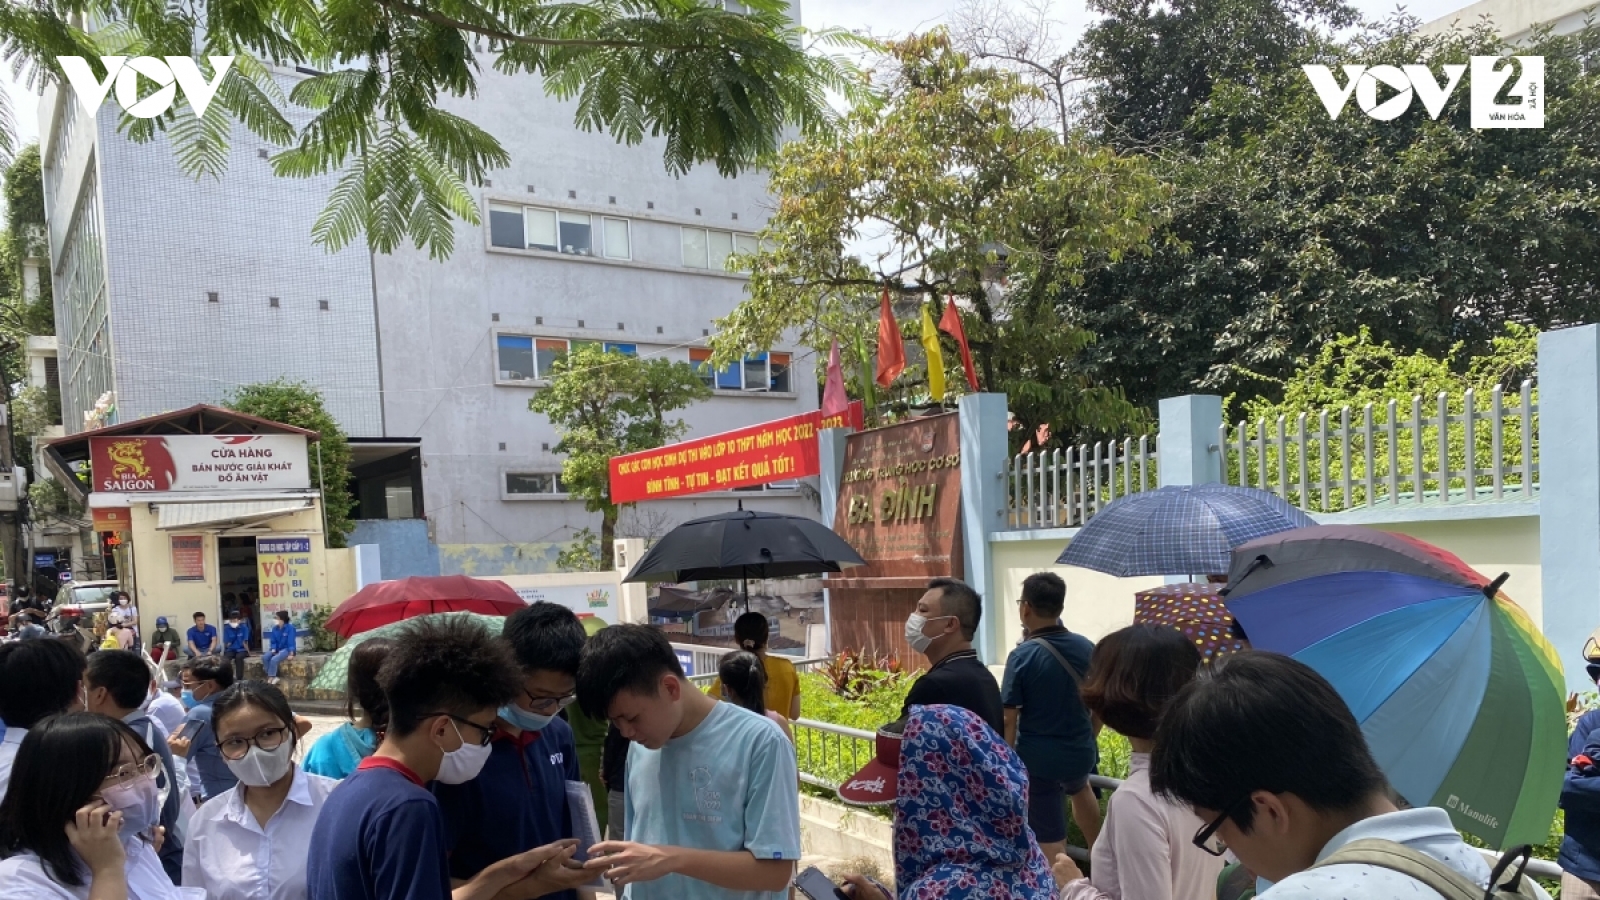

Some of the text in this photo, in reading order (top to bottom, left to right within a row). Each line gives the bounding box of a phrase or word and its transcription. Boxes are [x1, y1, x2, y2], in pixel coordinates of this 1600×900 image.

[211, 447, 273, 458] CỬA HÀNG
[652, 455, 664, 470] HỌC
[664, 453, 677, 466] SINH
[688, 447, 698, 462] THI
[698, 444, 712, 460] VÀO
[713, 440, 726, 457] LỚP
[727, 440, 736, 454] 10
[736, 435, 755, 453] THPT
[756, 429, 774, 449] NĂM
[775, 427, 792, 447] HỌC
[794, 422, 814, 441] 2022
[192, 461, 292, 472] BÁN NƯỚC GIẢI KHÁT
[646, 478, 663, 494] BÌNH
[664, 475, 680, 491] TĨNH
[685, 472, 695, 491] TỰ
[696, 471, 709, 487] TIN
[715, 467, 732, 485] ĐẠT
[733, 460, 749, 481] KẾT
[751, 454, 770, 479] QUẢ
[905, 459, 926, 477] HỌC
[104, 480, 155, 491] SAIGON
[121, 473, 137, 481] BIA
[235, 473, 249, 482] ĂN
[250, 472, 269, 484] VẬT
[847, 475, 936, 525] BA ĐÌNH
[261, 555, 285, 578] VỞ
[262, 580, 285, 598] BÚT
[1457, 802, 1499, 829] Manulife
